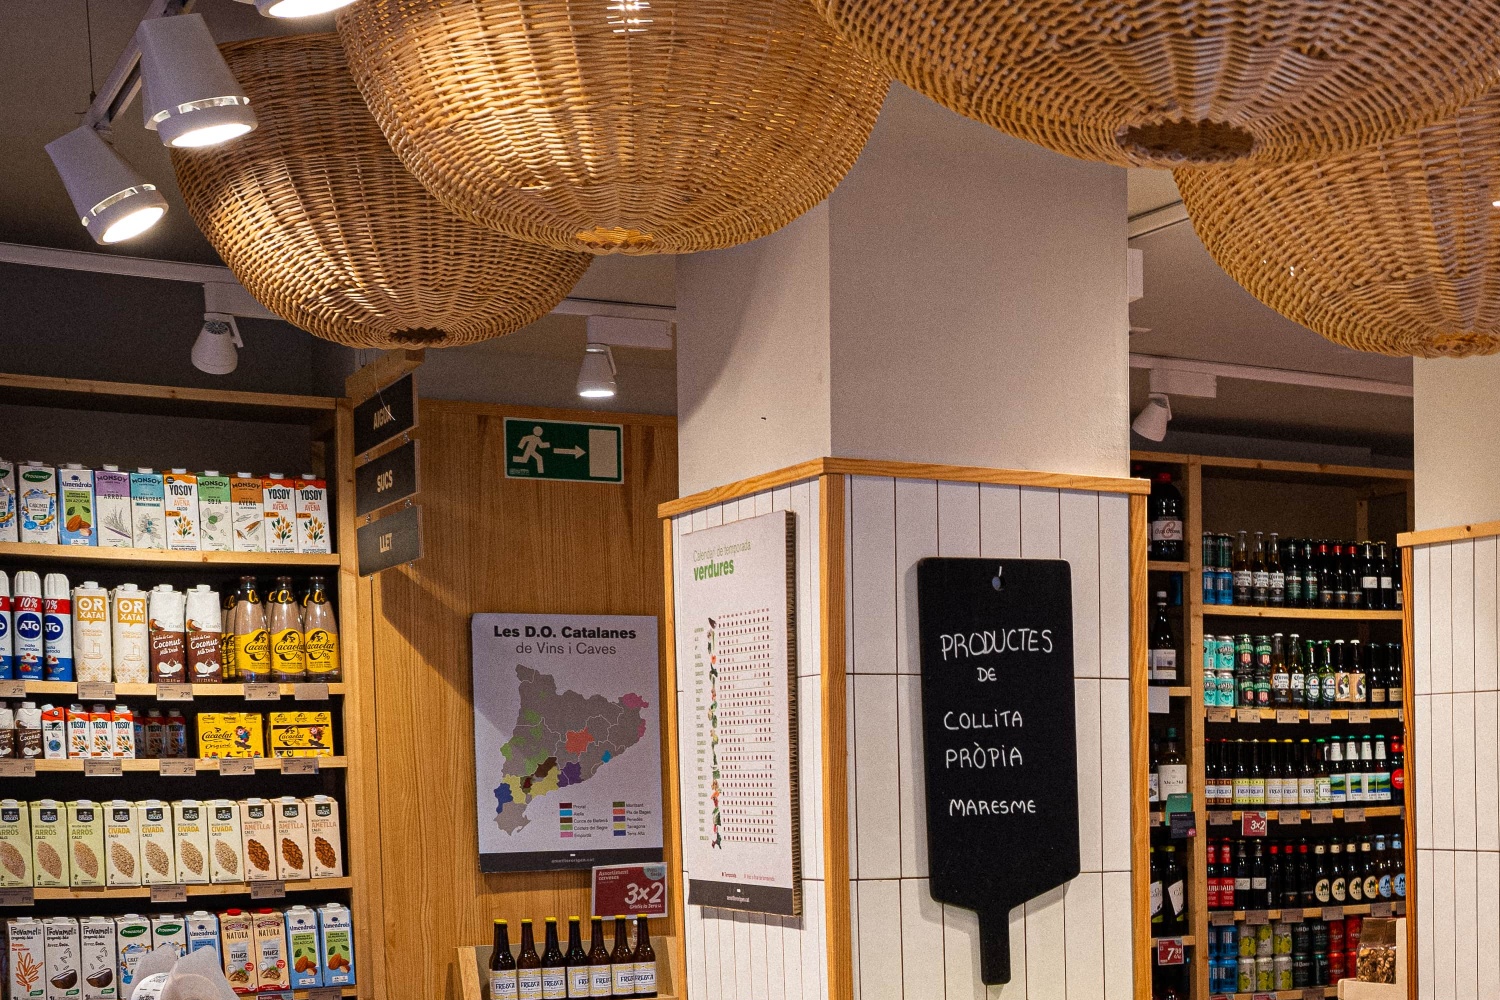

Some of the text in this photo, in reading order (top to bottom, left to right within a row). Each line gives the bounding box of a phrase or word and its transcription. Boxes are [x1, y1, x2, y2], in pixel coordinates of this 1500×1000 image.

[376, 469, 393, 493] SUCS
[169, 485, 193, 496] YOSOY
[267, 488, 291, 500] YOSOY
[300, 489, 323, 501] YOSOY
[379, 532, 393, 553] LLET
[693, 559, 735, 581] verdures
[19, 620, 40, 631] ATO
[493, 625, 637, 639] Les D.O. Catalanes
[153, 639, 182, 651] Coconut
[190, 639, 219, 650] Coconut
[515, 642, 532, 654] de
[536, 642, 565, 654] Vins
[576, 642, 617, 655] Caves
[939, 627, 1053, 661] PRODUCTES
[976, 667, 998, 682] DE
[202, 732, 233, 742] Cacaolat
[949, 799, 1036, 817] MARESME
[141, 826, 164, 834] CIVADA
[624, 881, 664, 905] 3x2
[226, 931, 249, 940] NATURA
